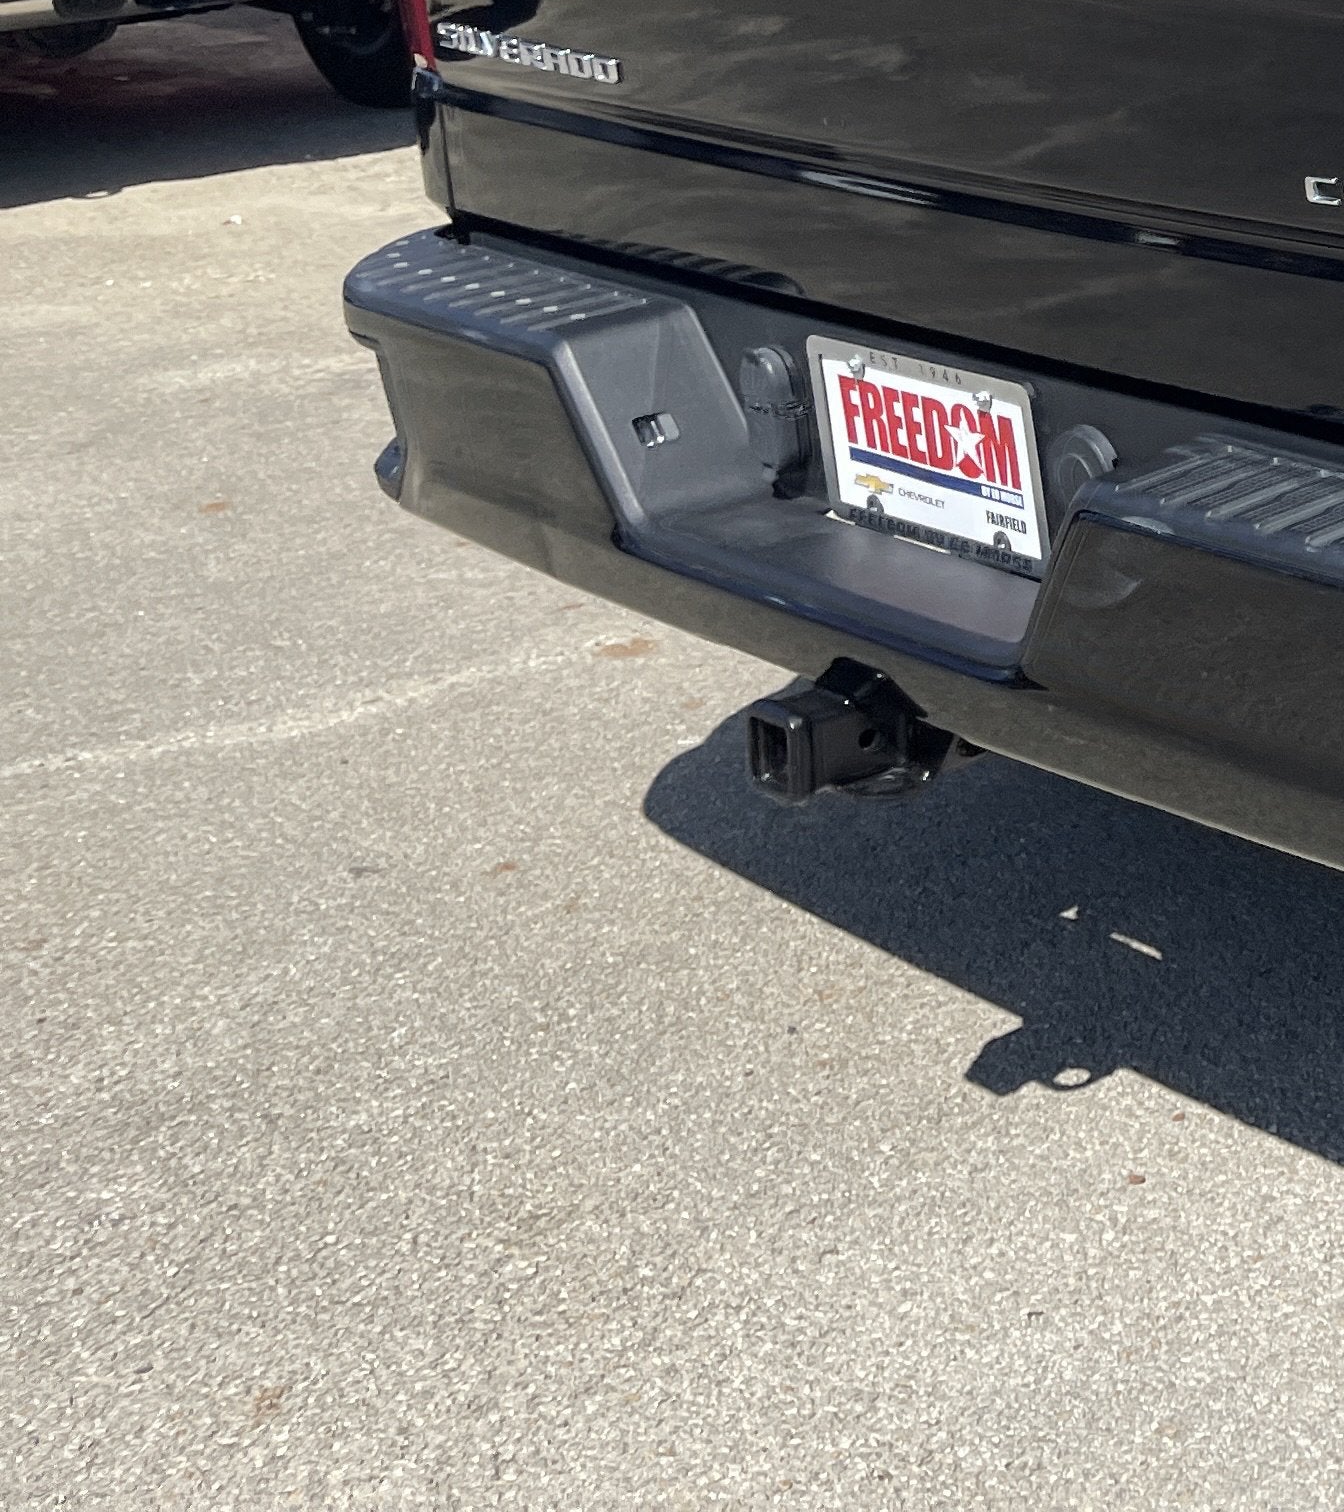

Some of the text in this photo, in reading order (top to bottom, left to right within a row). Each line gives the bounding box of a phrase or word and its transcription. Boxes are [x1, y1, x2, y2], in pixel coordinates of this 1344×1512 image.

[437, 22, 624, 85] SILVERADO
[837, 373, 1022, 491] FREEDOM
[897, 487, 945, 510] CHEVROLET
[986, 509, 1027, 535] FAIRFIELD
